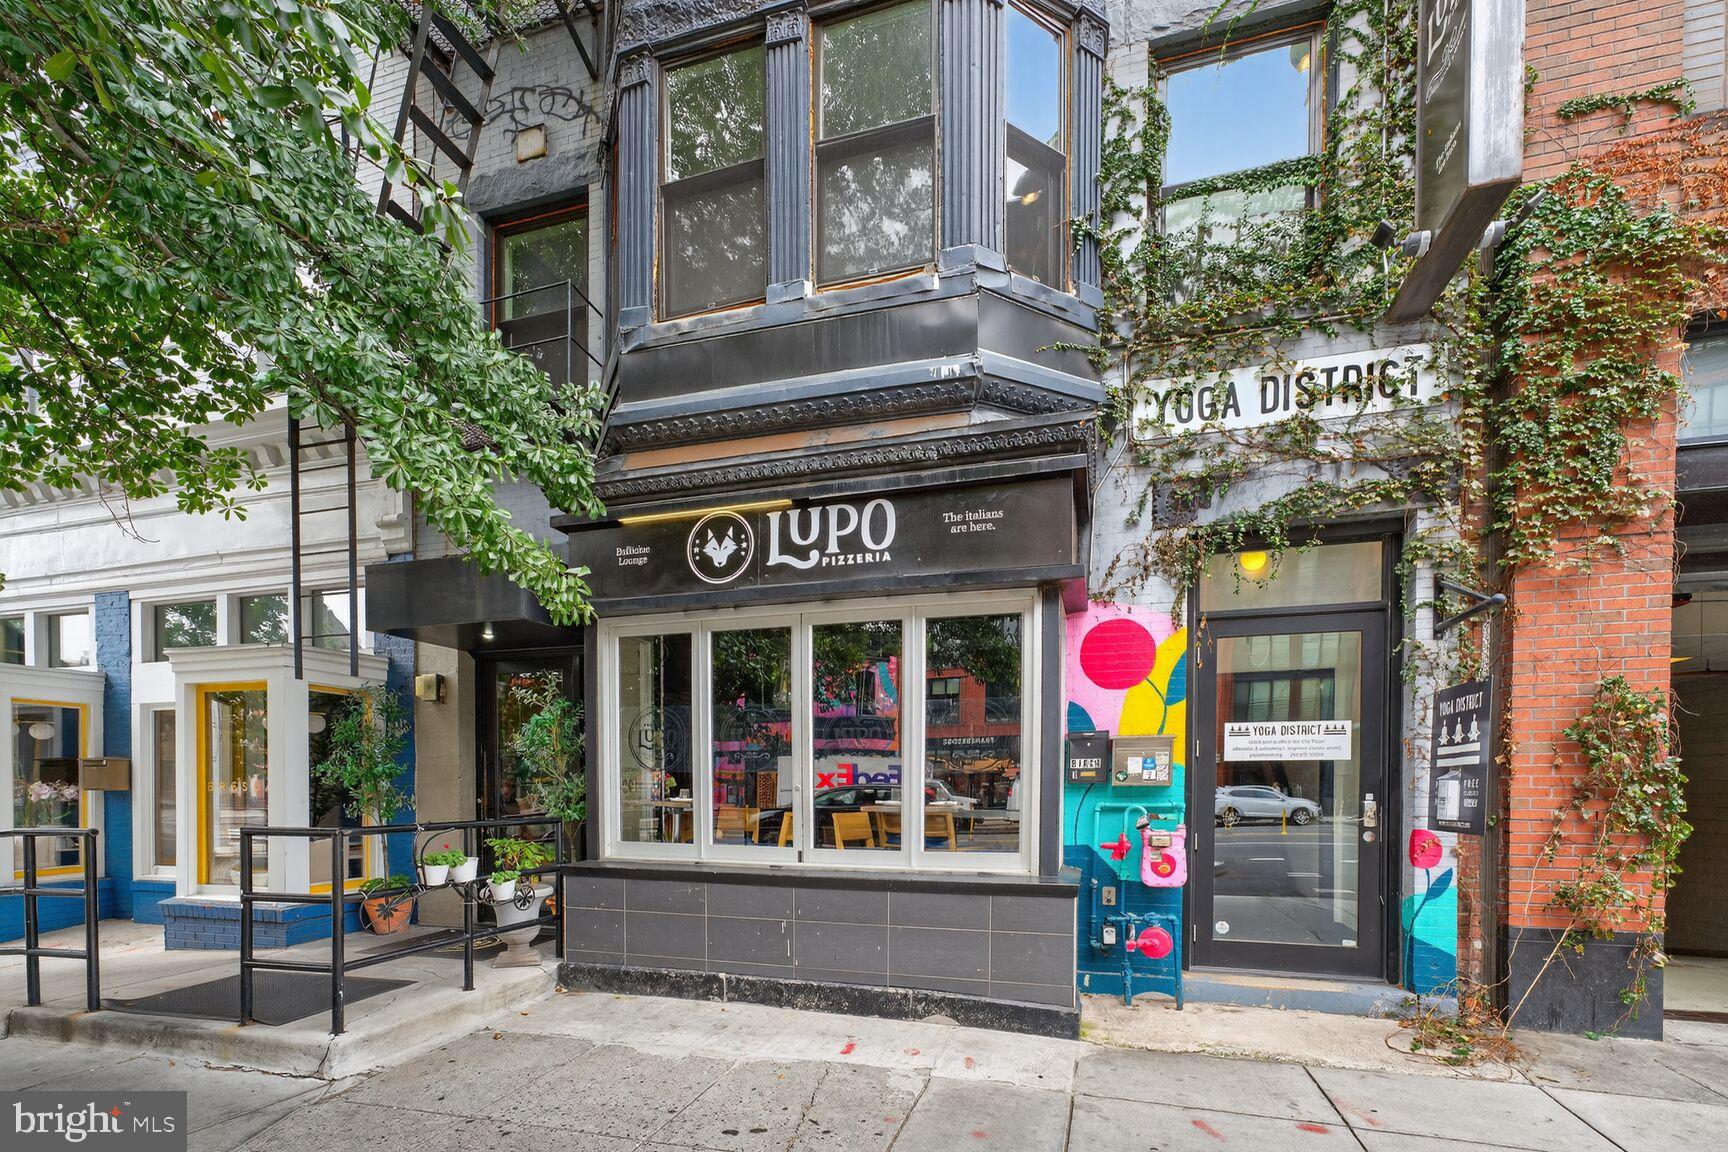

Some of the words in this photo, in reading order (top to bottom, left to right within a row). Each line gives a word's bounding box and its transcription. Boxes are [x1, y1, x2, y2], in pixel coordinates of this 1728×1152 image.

[1153, 382, 1241, 425] YOGA
[1260, 354, 1424, 414] DISTRICT
[943, 512, 964, 523] The
[965, 509, 1004, 521] italians
[766, 498, 896, 570] LUPO
[950, 524, 968, 534] are
[969, 521, 996, 533] here.
[822, 551, 892, 567] PIZZERIA
[1253, 725, 1277, 737] YOGA
[1280, 724, 1322, 736] DISTRICT
